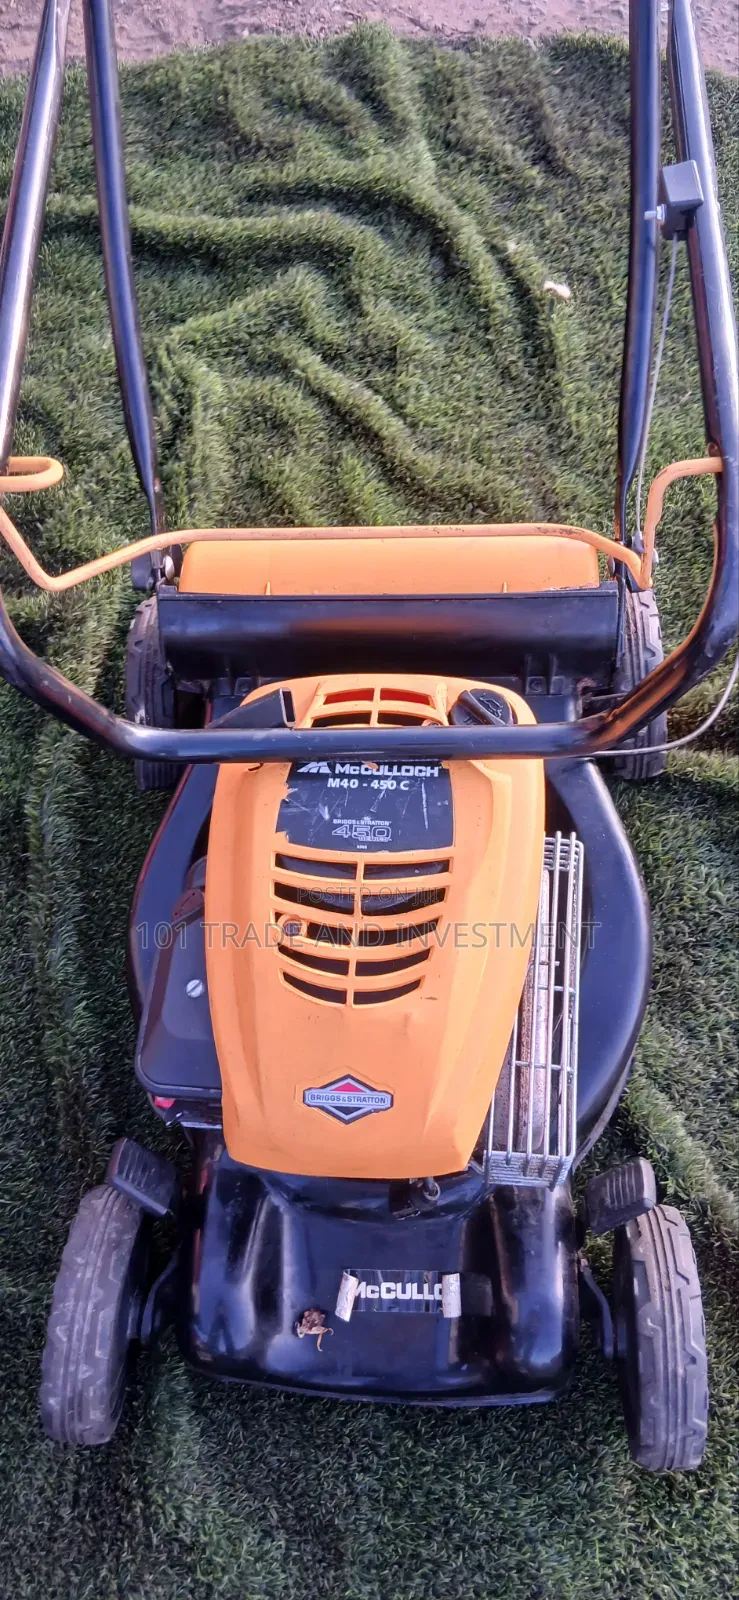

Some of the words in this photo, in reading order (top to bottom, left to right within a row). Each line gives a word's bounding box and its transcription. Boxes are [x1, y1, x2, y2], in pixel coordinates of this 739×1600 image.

[327, 777, 359, 789] M40
[370, 779, 397, 790] 450
[400, 780, 410, 791] C
[331, 824, 392, 838] 450
[310, 1093, 386, 1104] BRIGGS&STRATTON
